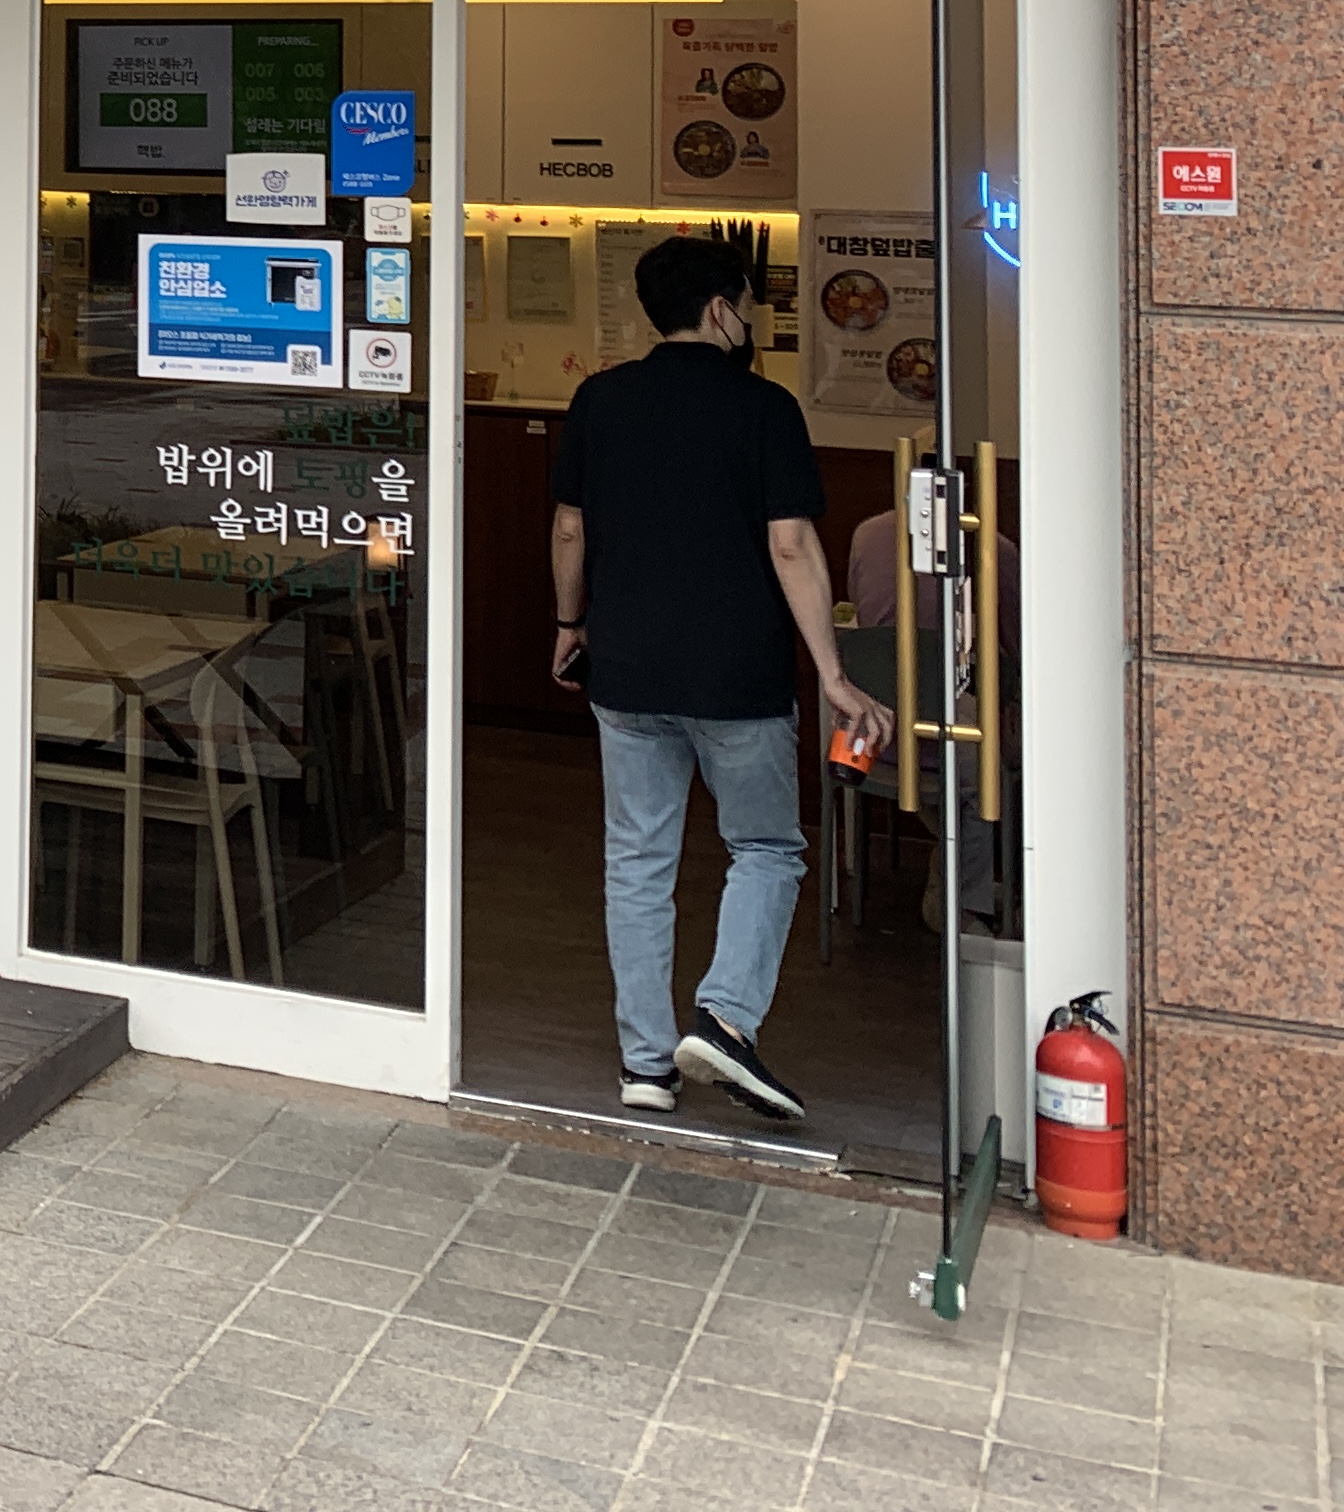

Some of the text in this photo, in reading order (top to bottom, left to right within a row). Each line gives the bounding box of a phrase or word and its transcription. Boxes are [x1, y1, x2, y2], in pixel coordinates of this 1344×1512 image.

[107, 71, 199, 86] 준비되었습니다
[129, 97, 178, 123] 088
[339, 101, 408, 125] CESCO
[539, 161, 614, 178] HECBOB
[1172, 165, 1222, 184] 에스원
[235, 194, 317, 208] 선한영향력가게
[158, 261, 211, 280] 친환경
[158, 279, 227, 299] 안심업소
[155, 443, 275, 494] 밥위에
[209, 497, 416, 556] 올려먹으면
